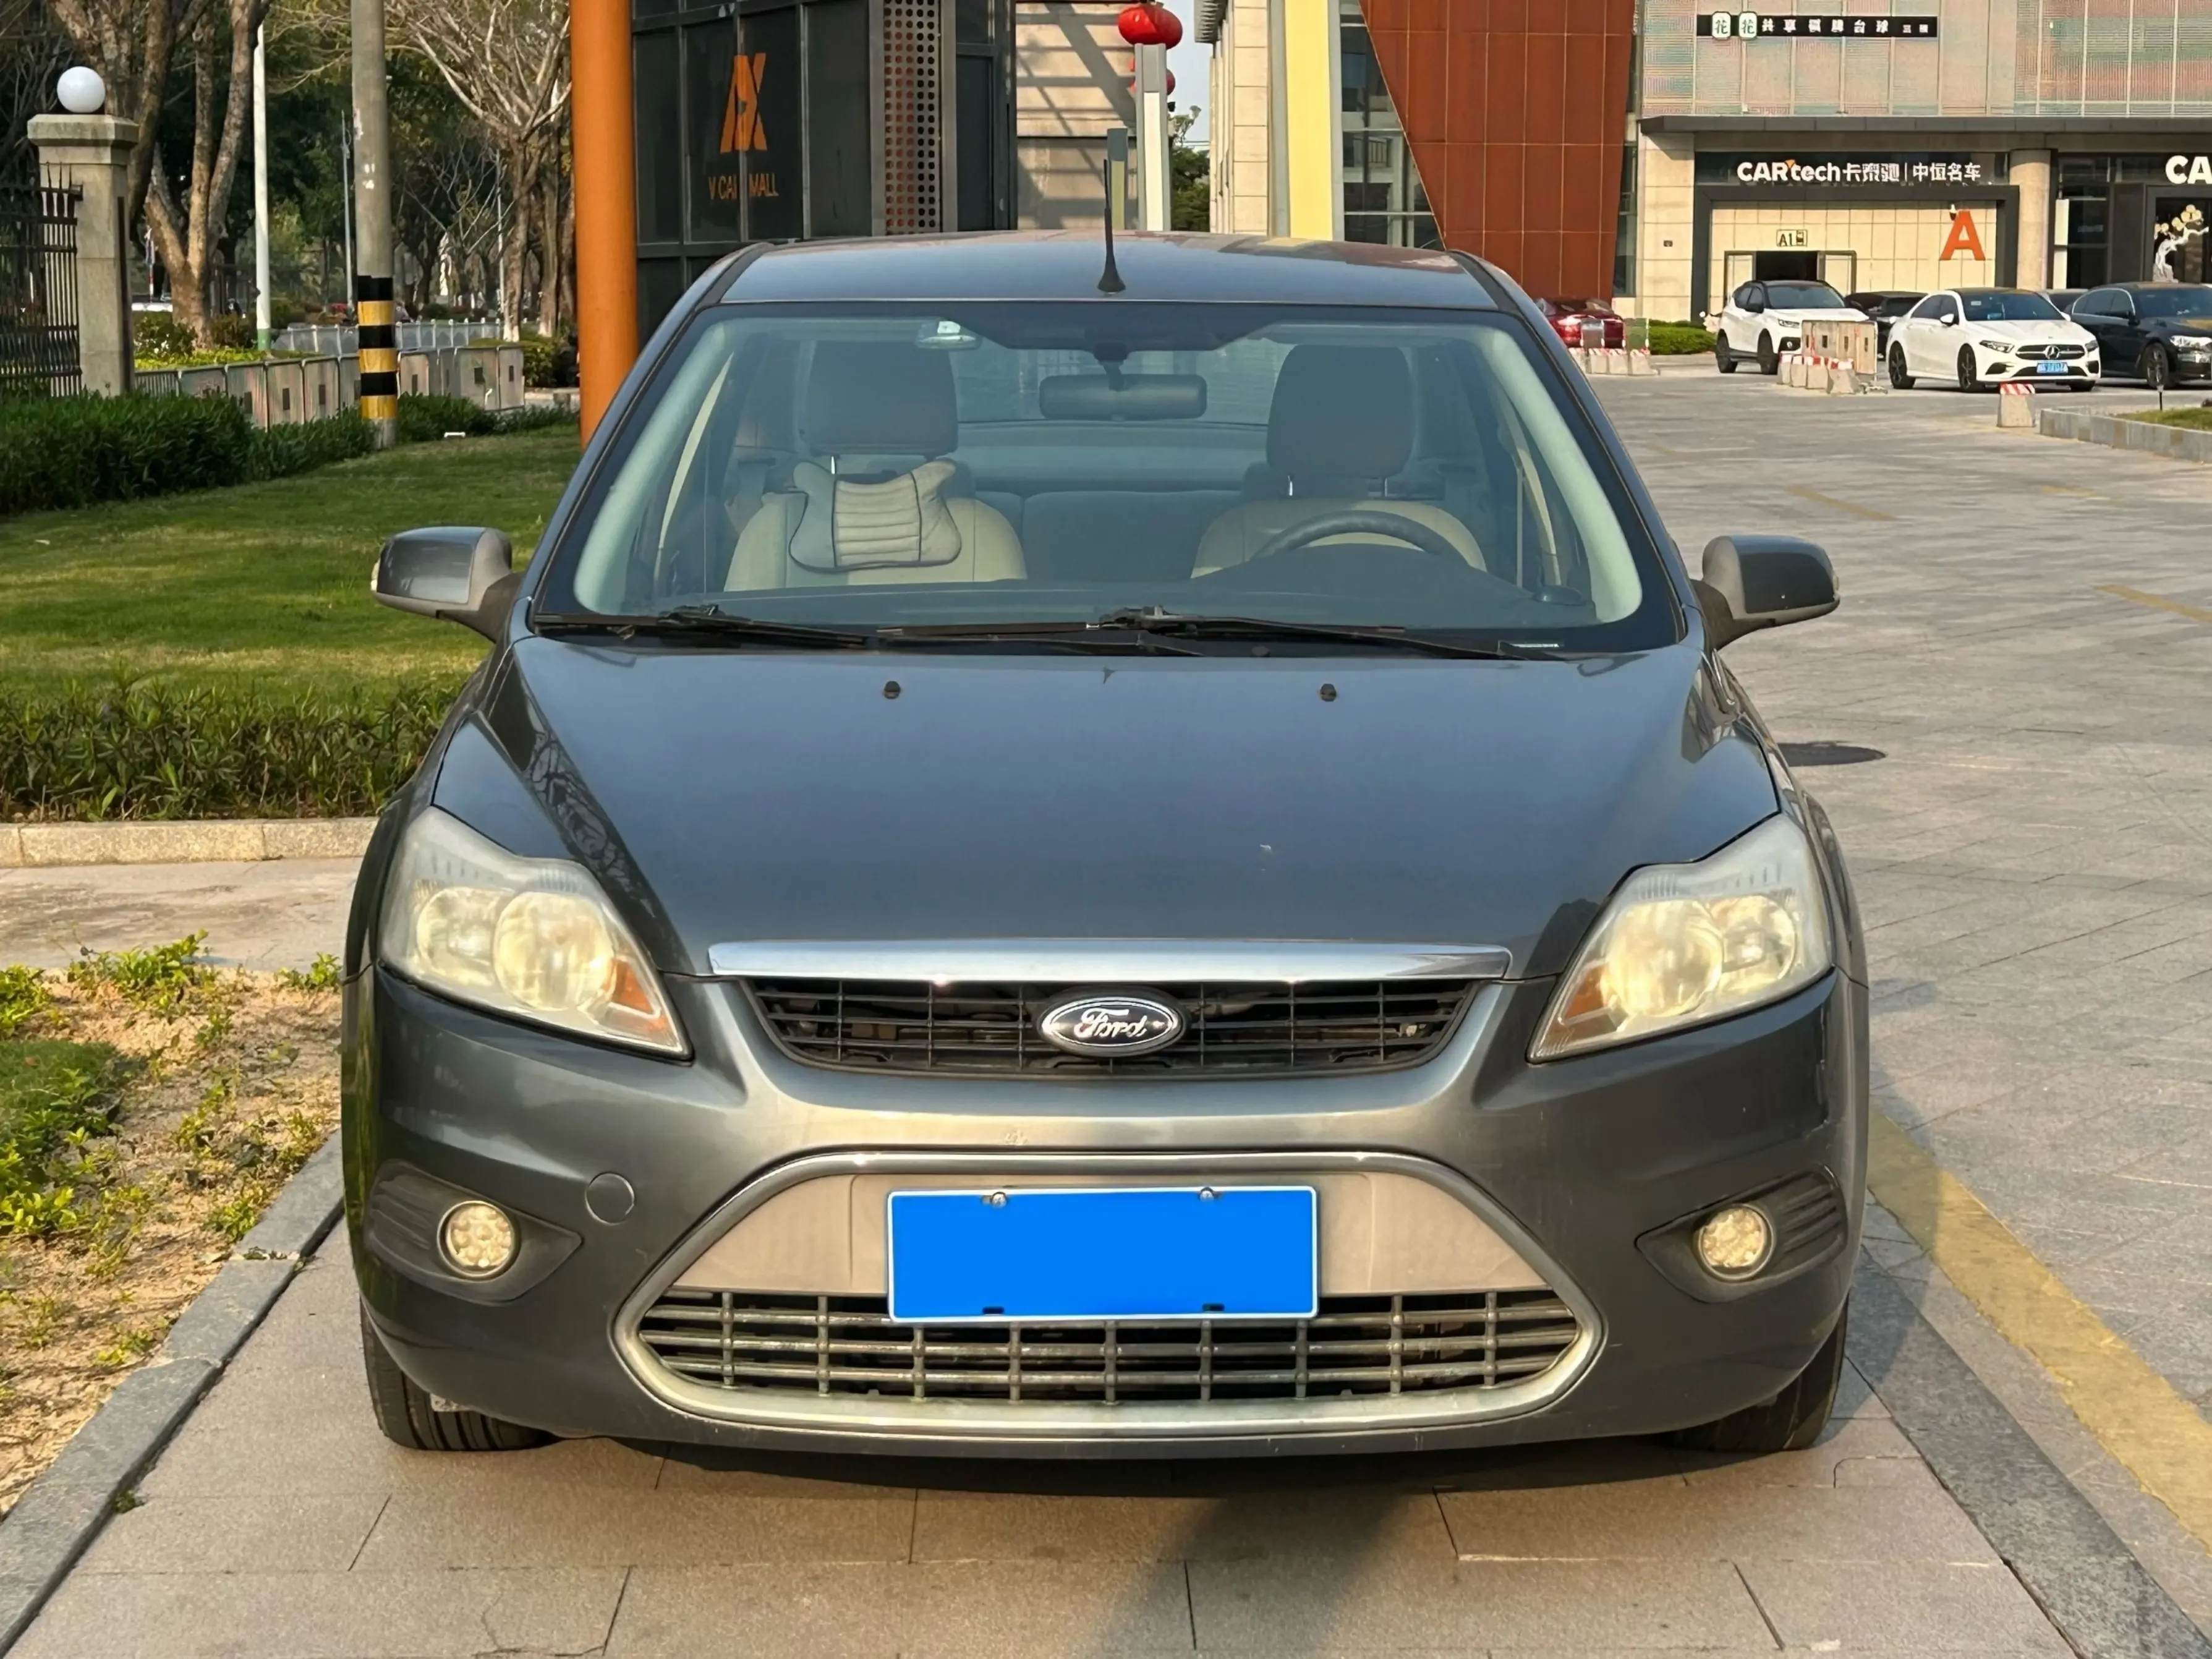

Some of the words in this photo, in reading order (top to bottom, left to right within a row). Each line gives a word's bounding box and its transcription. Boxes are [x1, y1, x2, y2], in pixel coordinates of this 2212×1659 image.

[749, 173, 779, 197] MALL
[1779, 232, 1793, 247] A1
[1939, 210, 1986, 261] A
[1073, 1007, 1149, 1039] Ford
